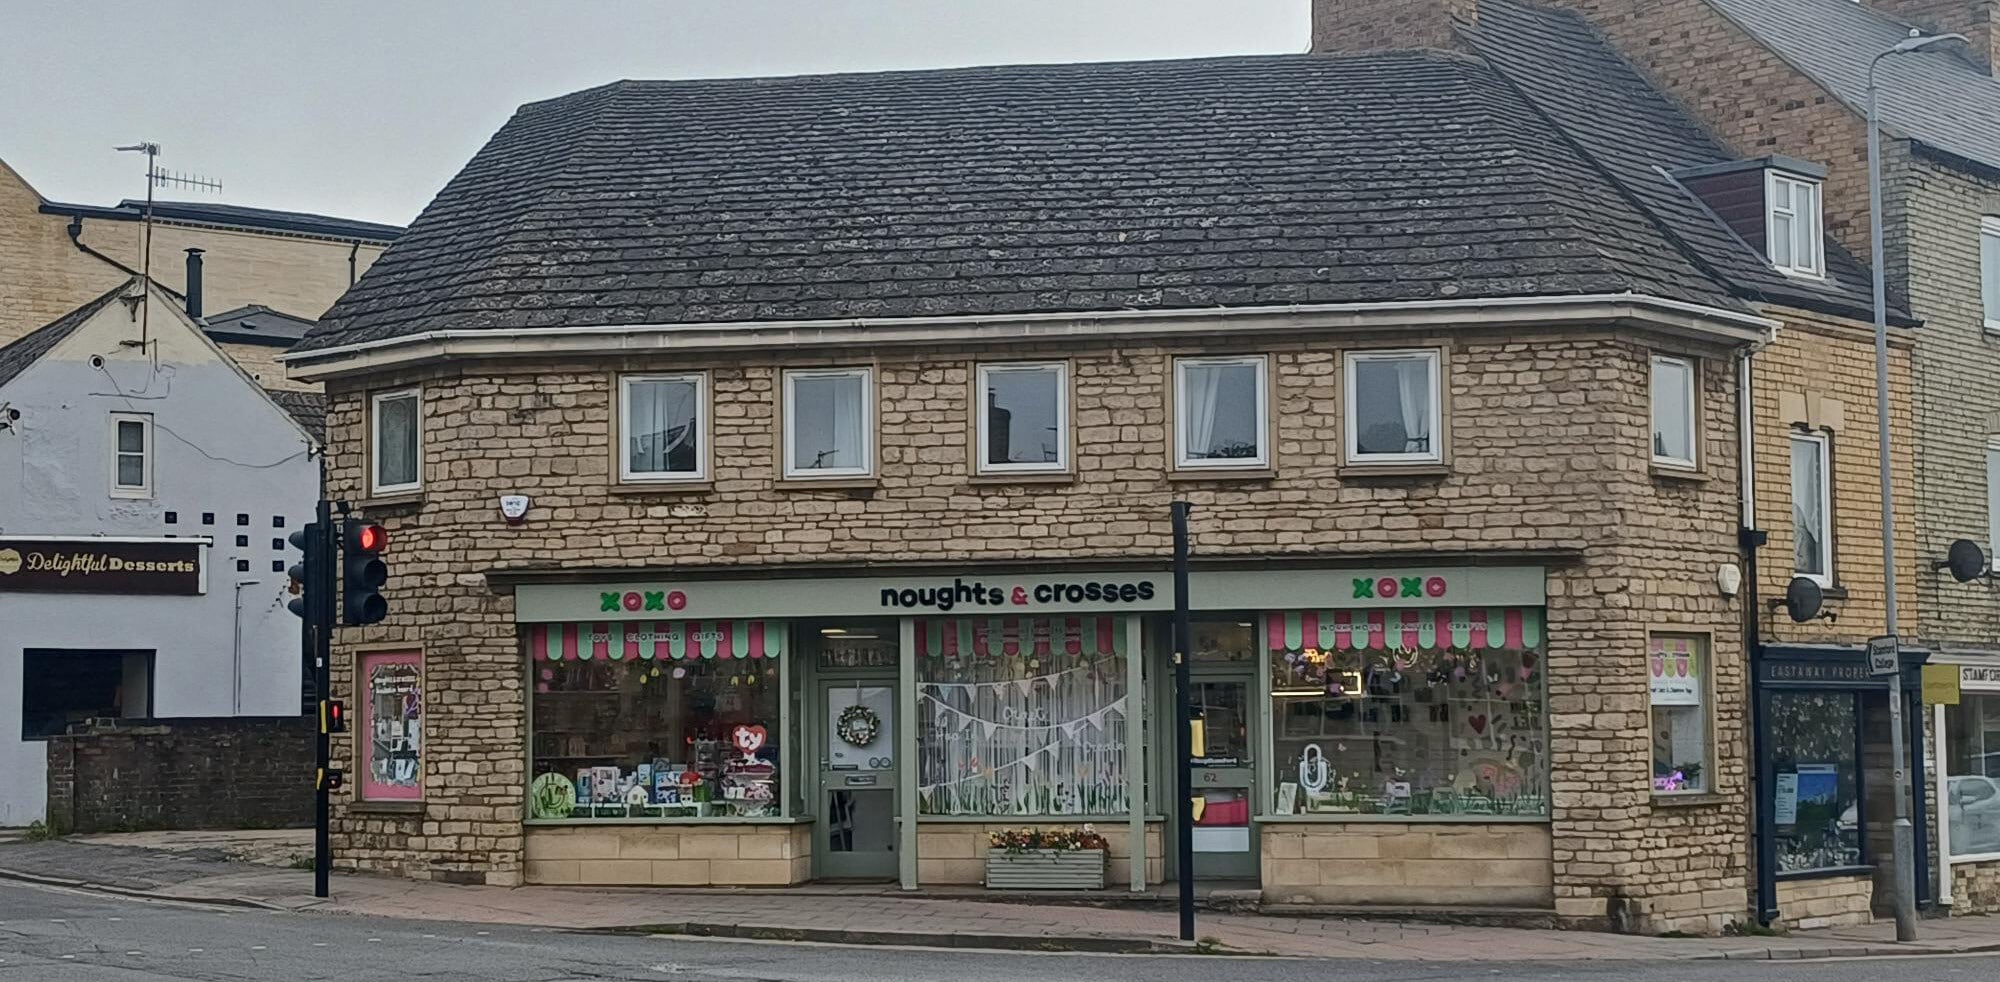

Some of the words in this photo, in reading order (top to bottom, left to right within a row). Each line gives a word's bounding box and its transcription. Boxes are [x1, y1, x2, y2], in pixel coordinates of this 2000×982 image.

[27, 552, 108, 577] Delightful
[109, 557, 194, 573] Desserts
[880, 578, 1005, 611] noughts
[1011, 586, 1029, 606] &
[1034, 580, 1155, 604] crosses
[588, 632, 613, 642] TOYS
[626, 632, 680, 642] CLOTHING
[692, 632, 724, 642] GIFTS
[735, 727, 763, 751] ty
[1204, 772, 1218, 783] 62
